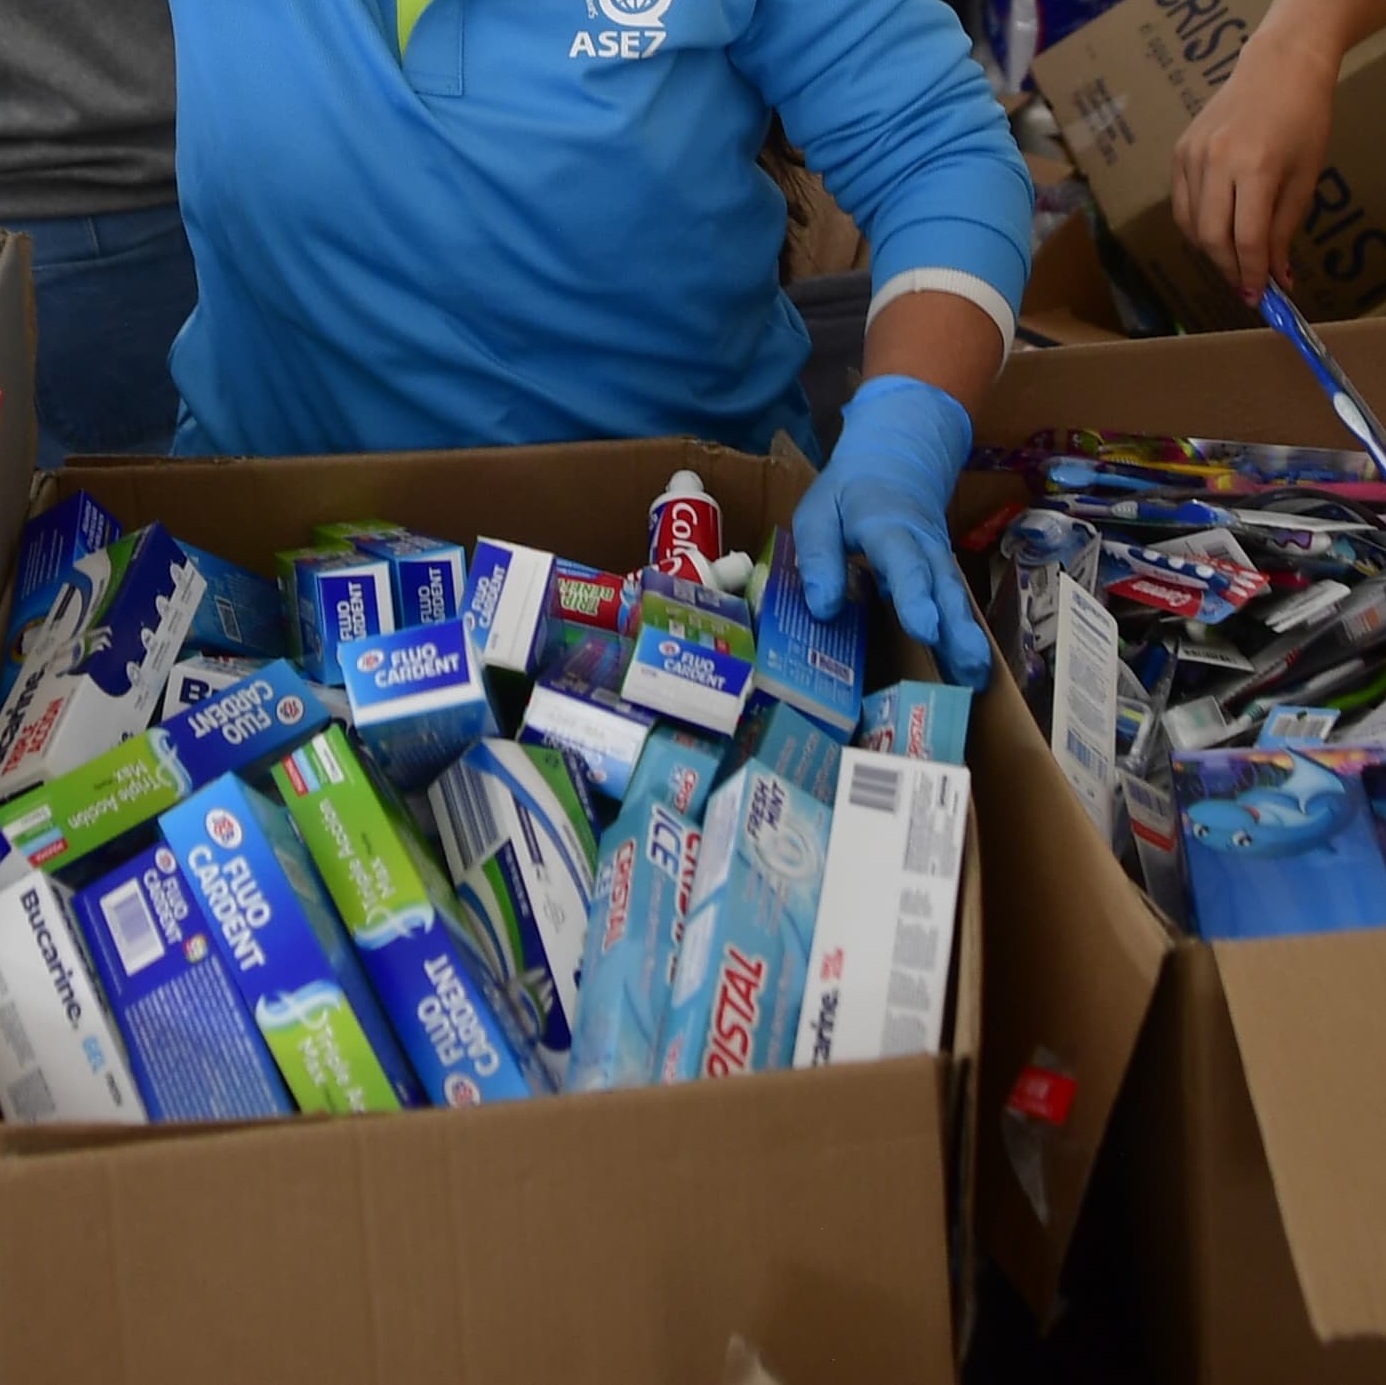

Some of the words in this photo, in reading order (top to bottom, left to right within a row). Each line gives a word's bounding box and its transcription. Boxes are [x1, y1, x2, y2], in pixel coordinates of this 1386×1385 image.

[568, 30, 667, 59] ASE7
[374, 653, 461, 688] CARDENT
[391, 642, 437, 668] FLUO
[663, 657, 727, 692] CARDENT
[680, 651, 715, 670] FLUO
[187, 679, 275, 738] CARDENT
[222, 709, 273, 745] FLUO
[747, 780, 767, 840] FRESH
[762, 781, 785, 831] MINT
[647, 803, 687, 875] ICE
[143, 868, 183, 945] CARDENT
[161, 874, 189, 922] FLUO
[188, 845, 266, 972] CARDENT
[221, 856, 271, 930] FLUO
[19, 886, 82, 1022] Bucarine
[417, 995, 465, 1068] FLUO
[424, 953, 500, 1077] CARDENT
[81, 1034, 104, 1076] GEL
